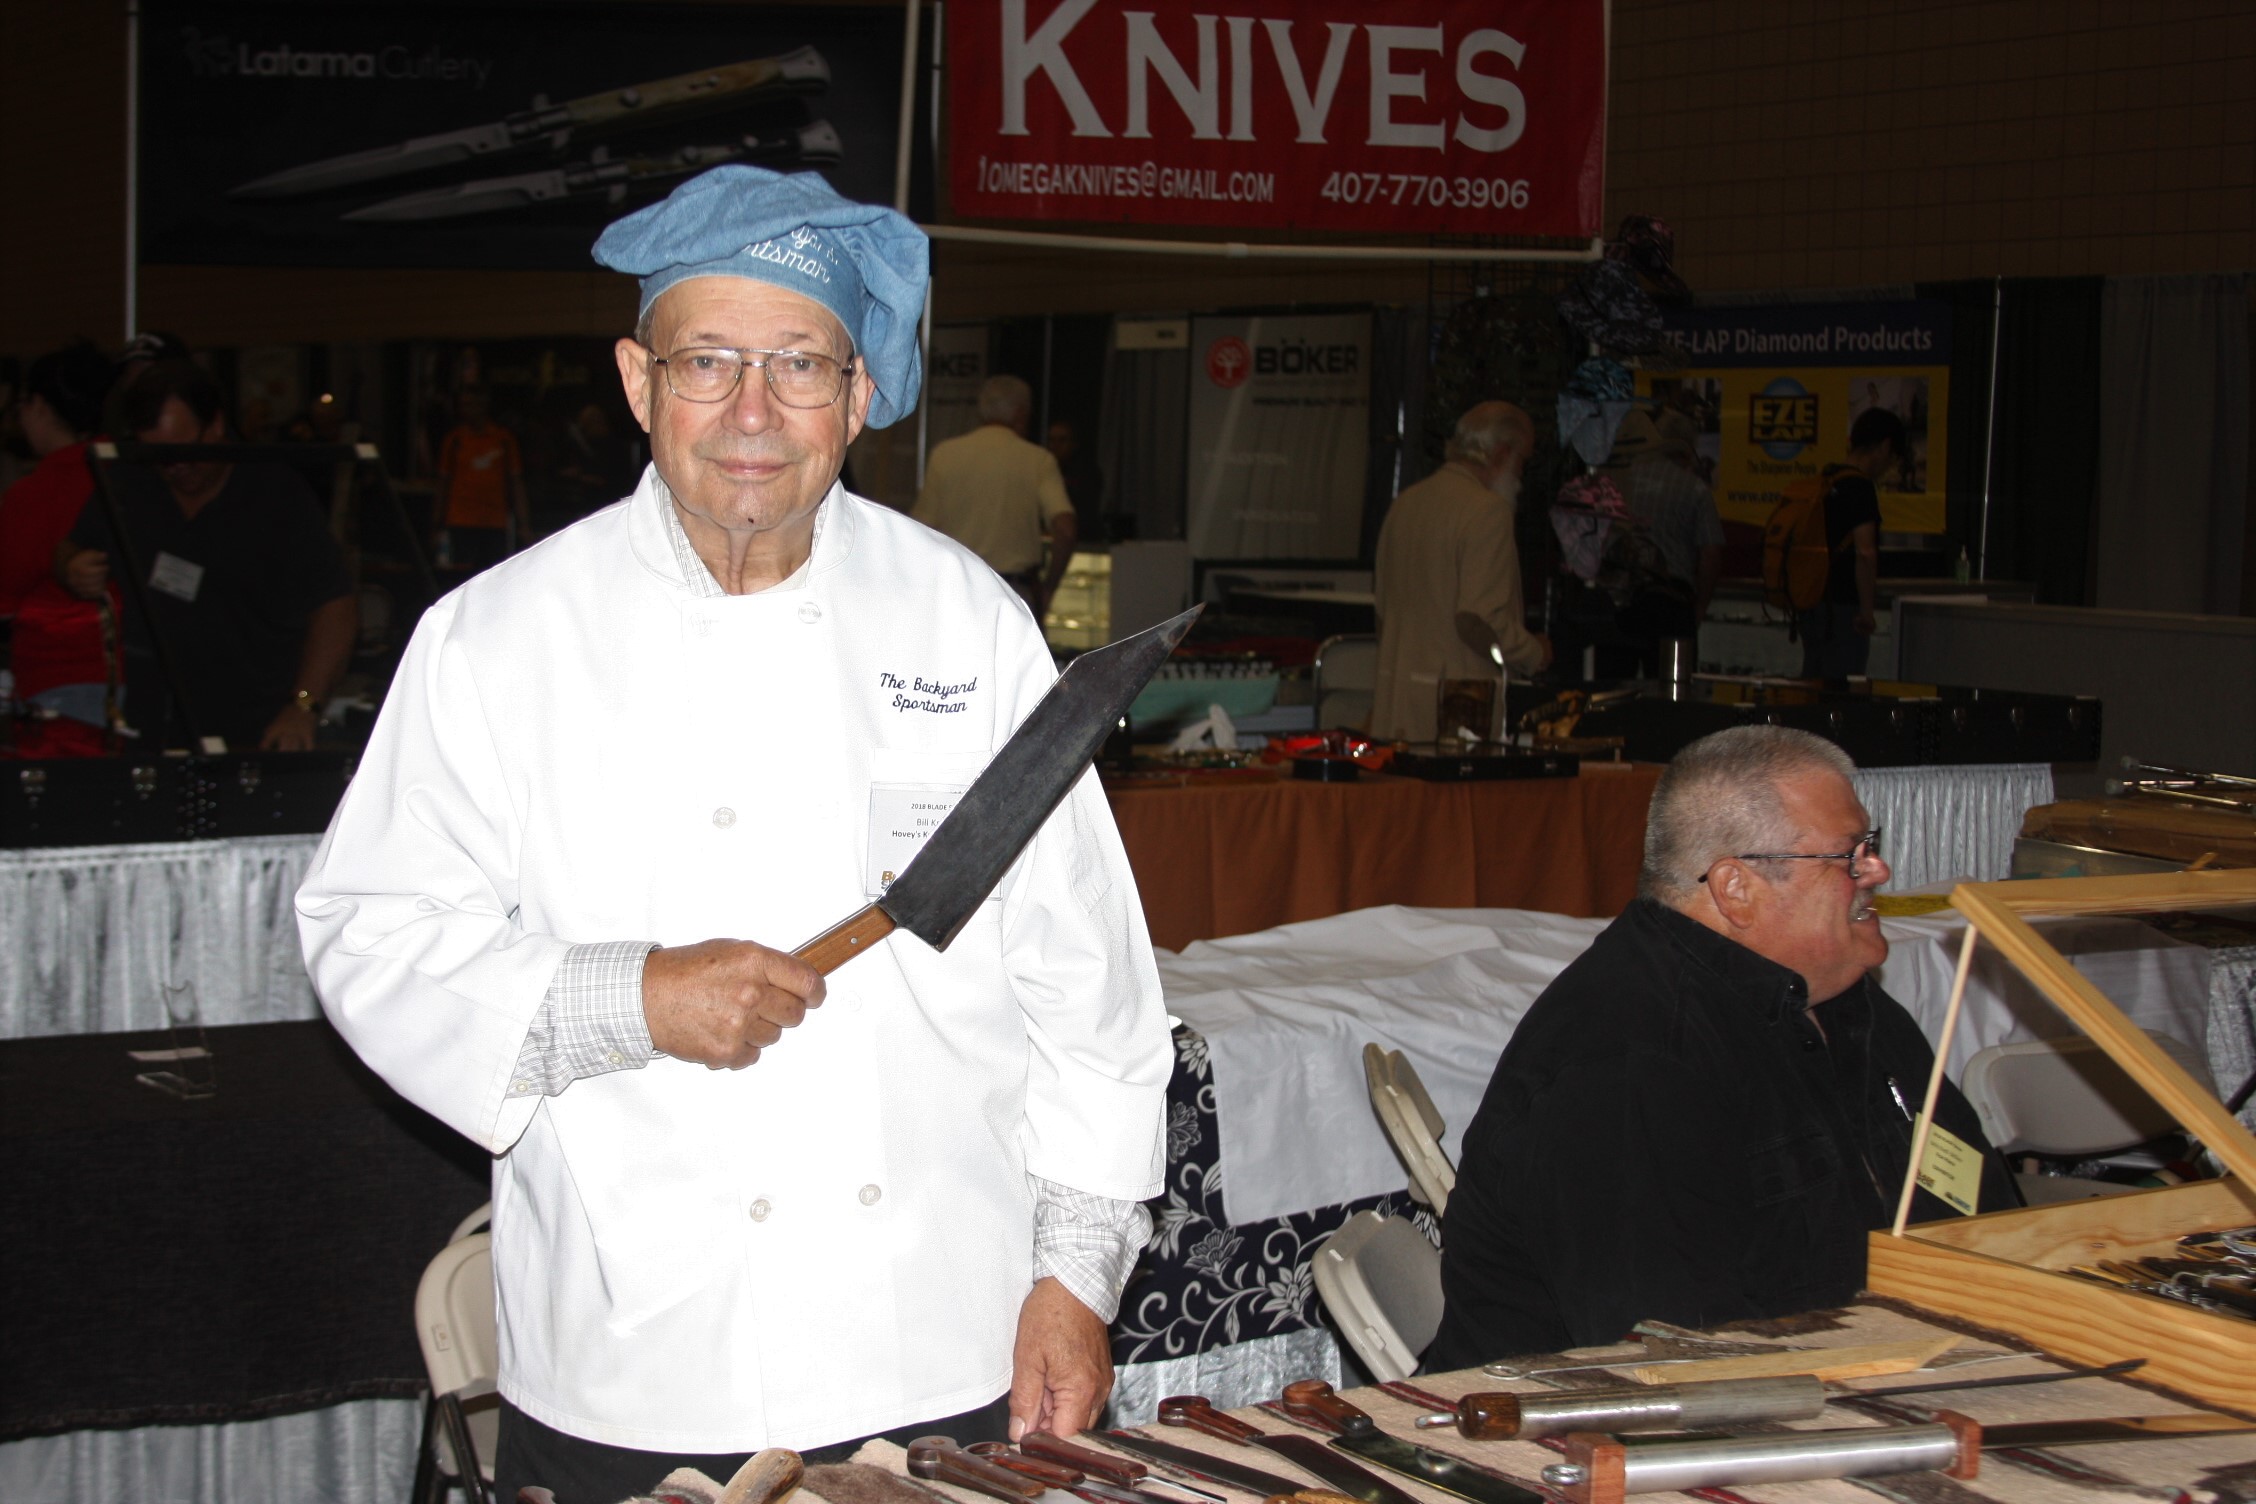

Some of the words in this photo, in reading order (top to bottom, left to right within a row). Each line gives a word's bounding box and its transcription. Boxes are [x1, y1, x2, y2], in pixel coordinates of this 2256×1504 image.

[237, 42, 376, 78] Latama
[378, 44, 496, 90] Cutlery
[998, 0, 1527, 155] KNIVES
[1322, 171, 1531, 210] 407-770-3906
[1735, 326, 1829, 353] Diamond
[1835, 324, 1933, 351] Products
[1255, 337, 1359, 374] BÖKER
[1753, 398, 1816, 425] EZE
[880, 672, 907, 690] The
[913, 677, 978, 700] Backyard
[892, 694, 968, 714] Sportsman
[892, 829, 921, 840] Hovey's
[916, 818, 929, 827] Bill
